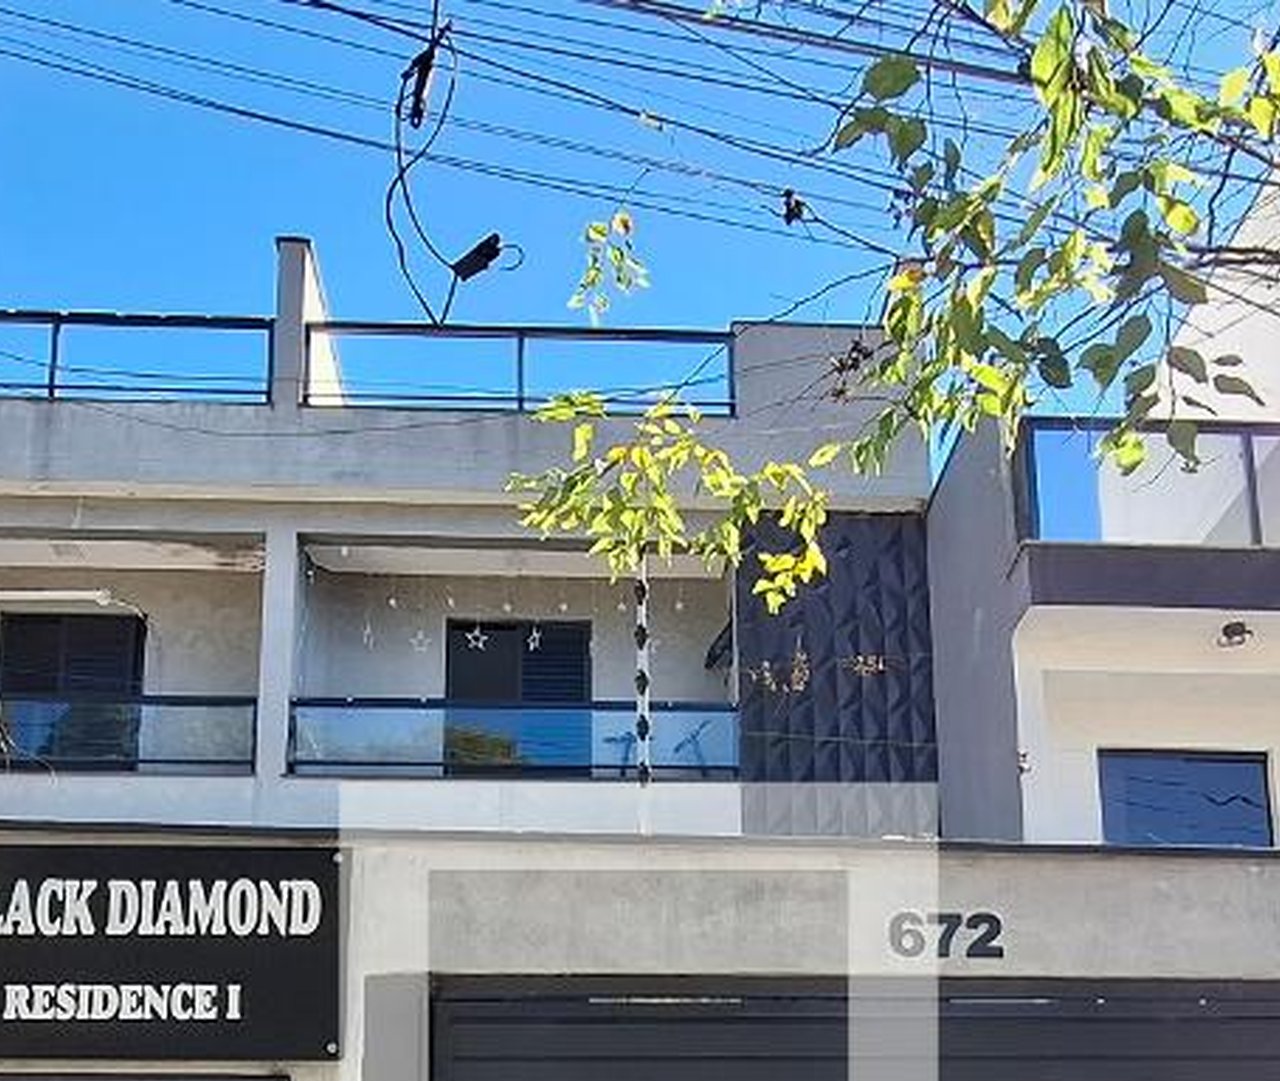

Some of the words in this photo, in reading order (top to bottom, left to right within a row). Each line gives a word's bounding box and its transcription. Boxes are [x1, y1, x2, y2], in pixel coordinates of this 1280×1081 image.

[104, 877, 322, 937] DIAMOND
[889, 911, 1004, 958] 672
[2, 982, 218, 1021] RESIDENCE
[225, 984, 242, 1020] I
